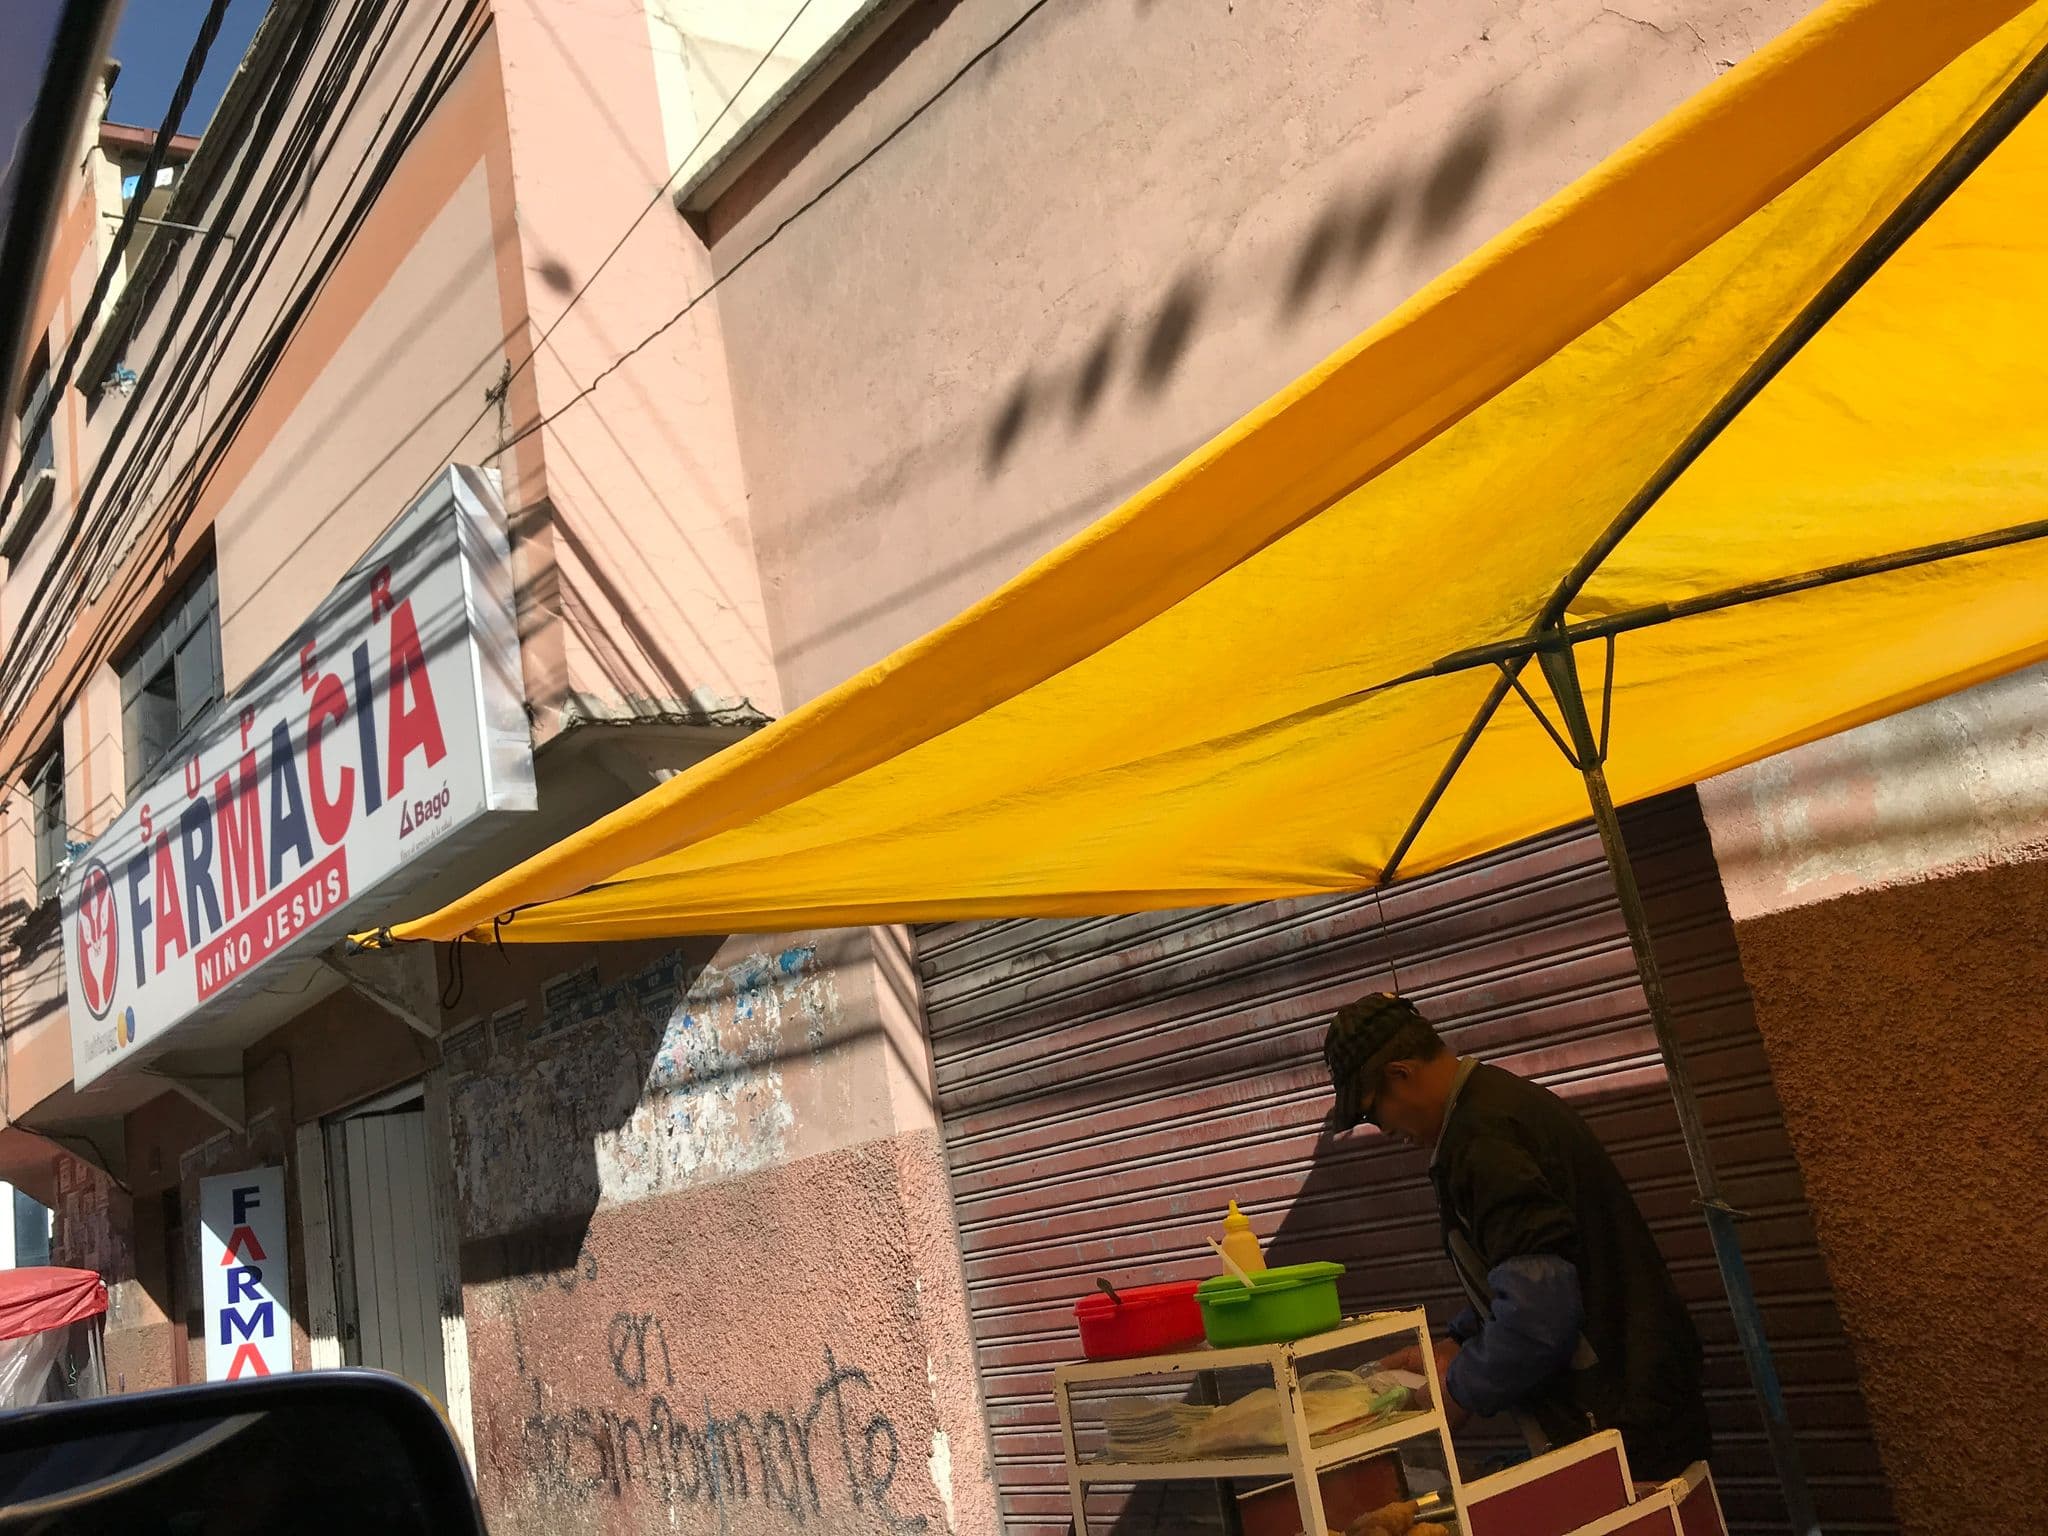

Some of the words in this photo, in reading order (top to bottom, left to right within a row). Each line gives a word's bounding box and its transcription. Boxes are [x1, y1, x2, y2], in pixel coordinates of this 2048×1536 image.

[127, 598, 447, 990] FARMACIA
[139, 564, 395, 843] SUPER
[414, 779, 450, 828] Bagó
[201, 936, 251, 991] NIÑO
[263, 868, 341, 948] JESUS
[220, 1186, 275, 1382] FARMA
